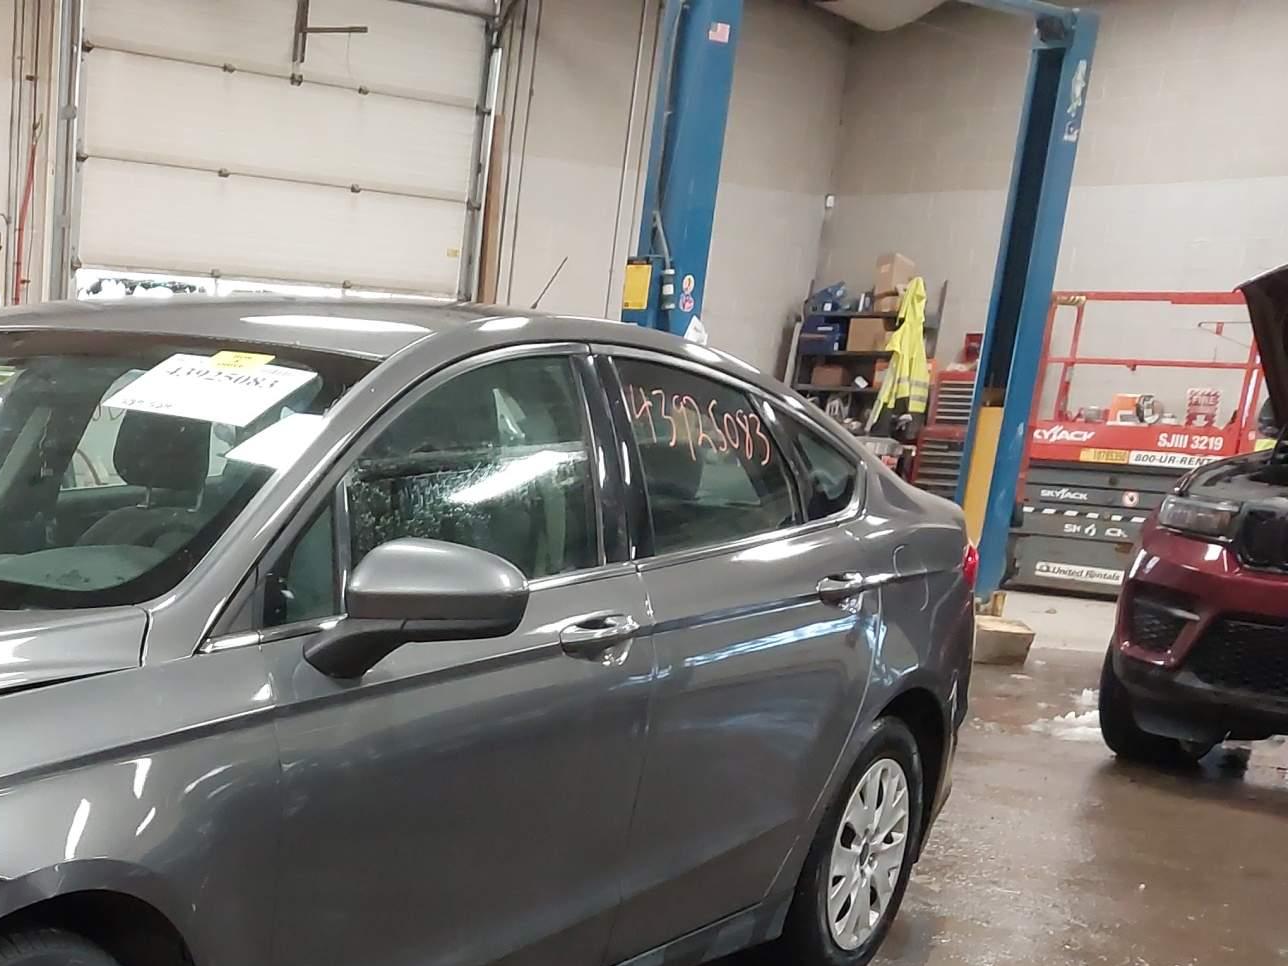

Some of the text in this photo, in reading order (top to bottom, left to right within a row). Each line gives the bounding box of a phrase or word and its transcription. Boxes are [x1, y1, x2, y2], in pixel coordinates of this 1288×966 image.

[166, 366, 280, 388] 43925083
[629, 384, 772, 466] 43925083
[1191, 435, 1224, 450] 3219
[1040, 488, 1089, 501] SKYJACK
[1052, 566, 1121, 581] United Rentals
